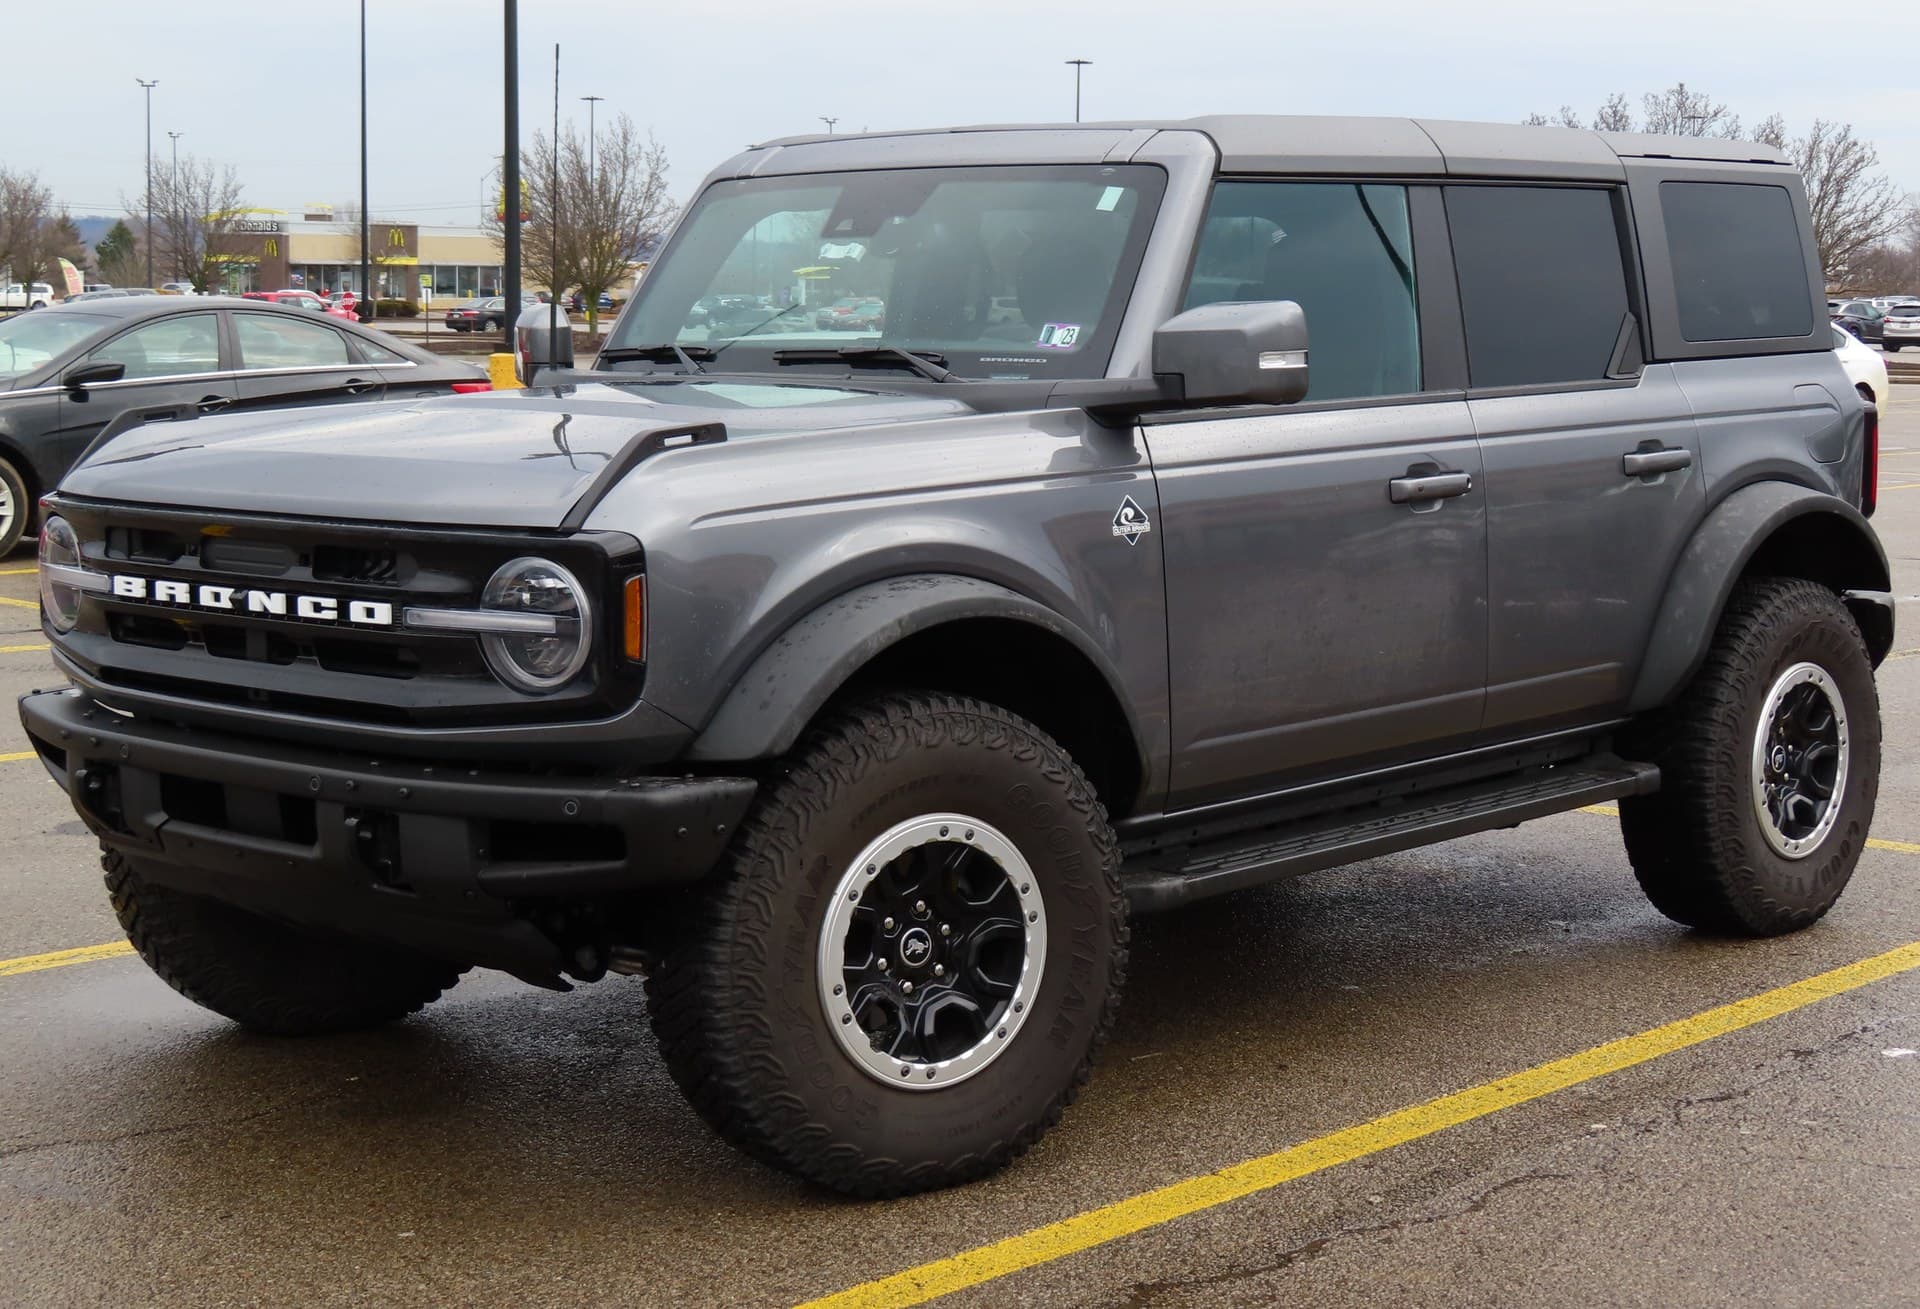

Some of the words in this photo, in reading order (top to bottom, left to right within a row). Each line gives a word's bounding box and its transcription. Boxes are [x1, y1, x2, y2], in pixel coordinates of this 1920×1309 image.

[342, 297, 355, 306] STOP
[1061, 328, 1075, 345] 23
[113, 574, 393, 625] BRONCO
